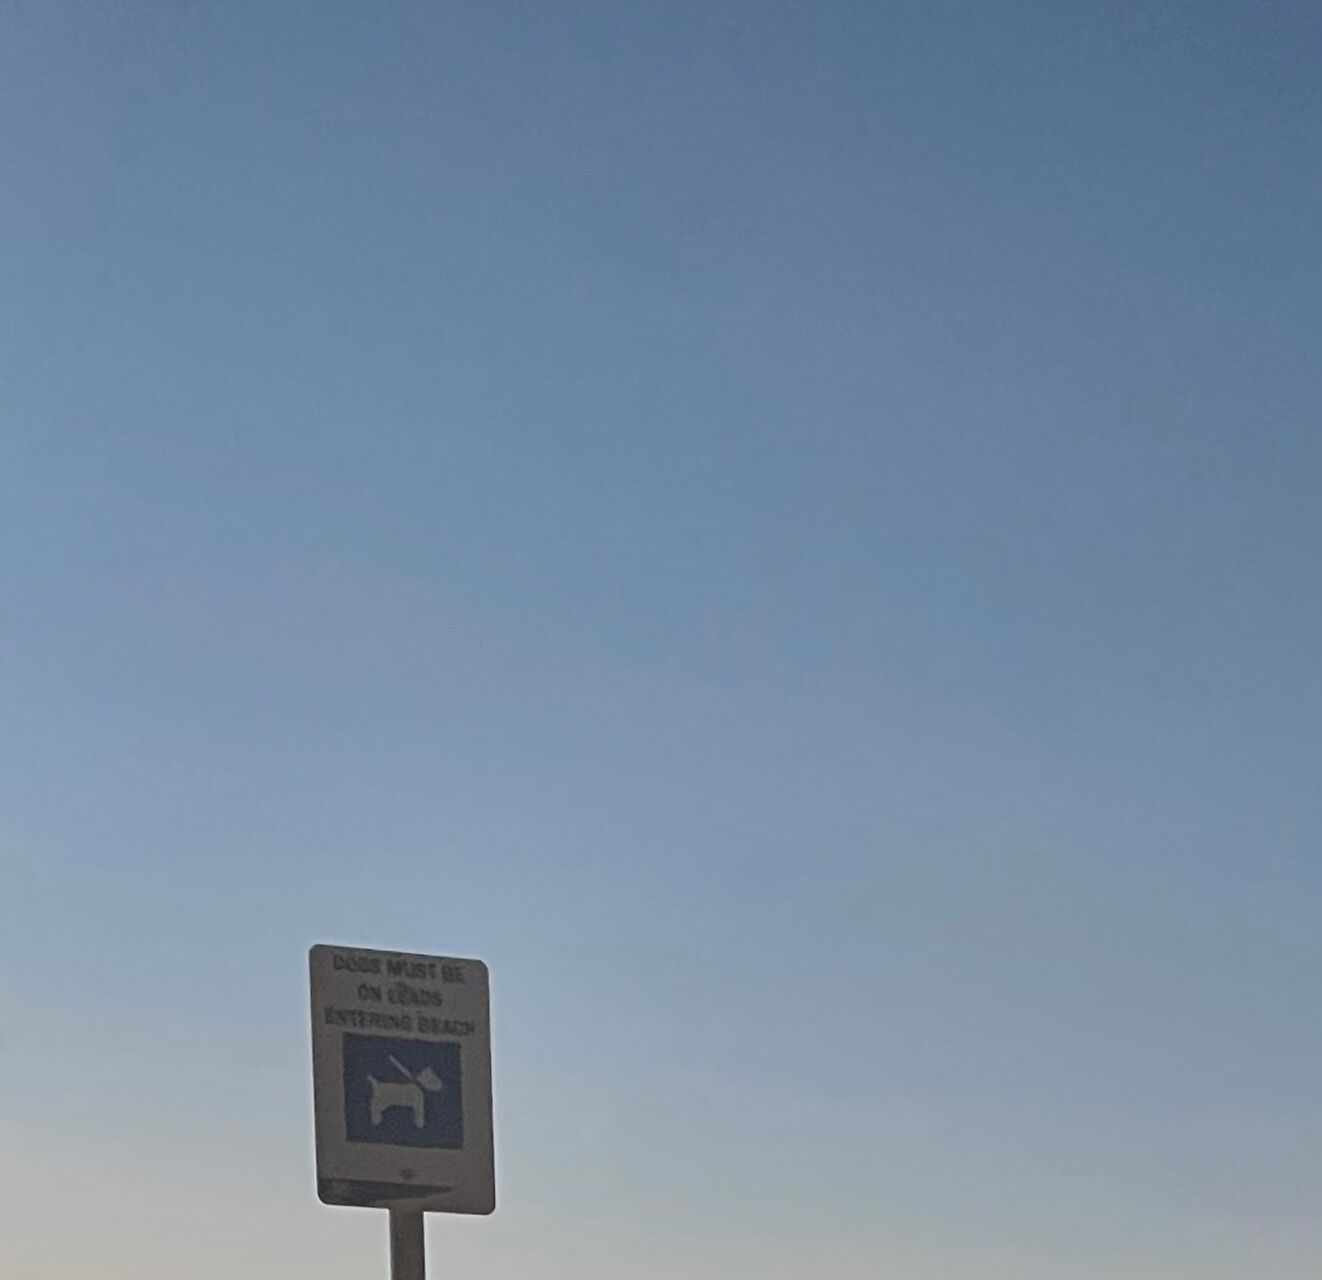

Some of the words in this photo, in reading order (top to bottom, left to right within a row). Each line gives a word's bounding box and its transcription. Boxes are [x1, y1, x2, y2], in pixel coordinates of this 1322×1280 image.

[386, 959, 437, 980] MUST
[442, 965, 465, 983] BE
[358, 983, 381, 1002] ON
[387, 985, 443, 1007] LEADS
